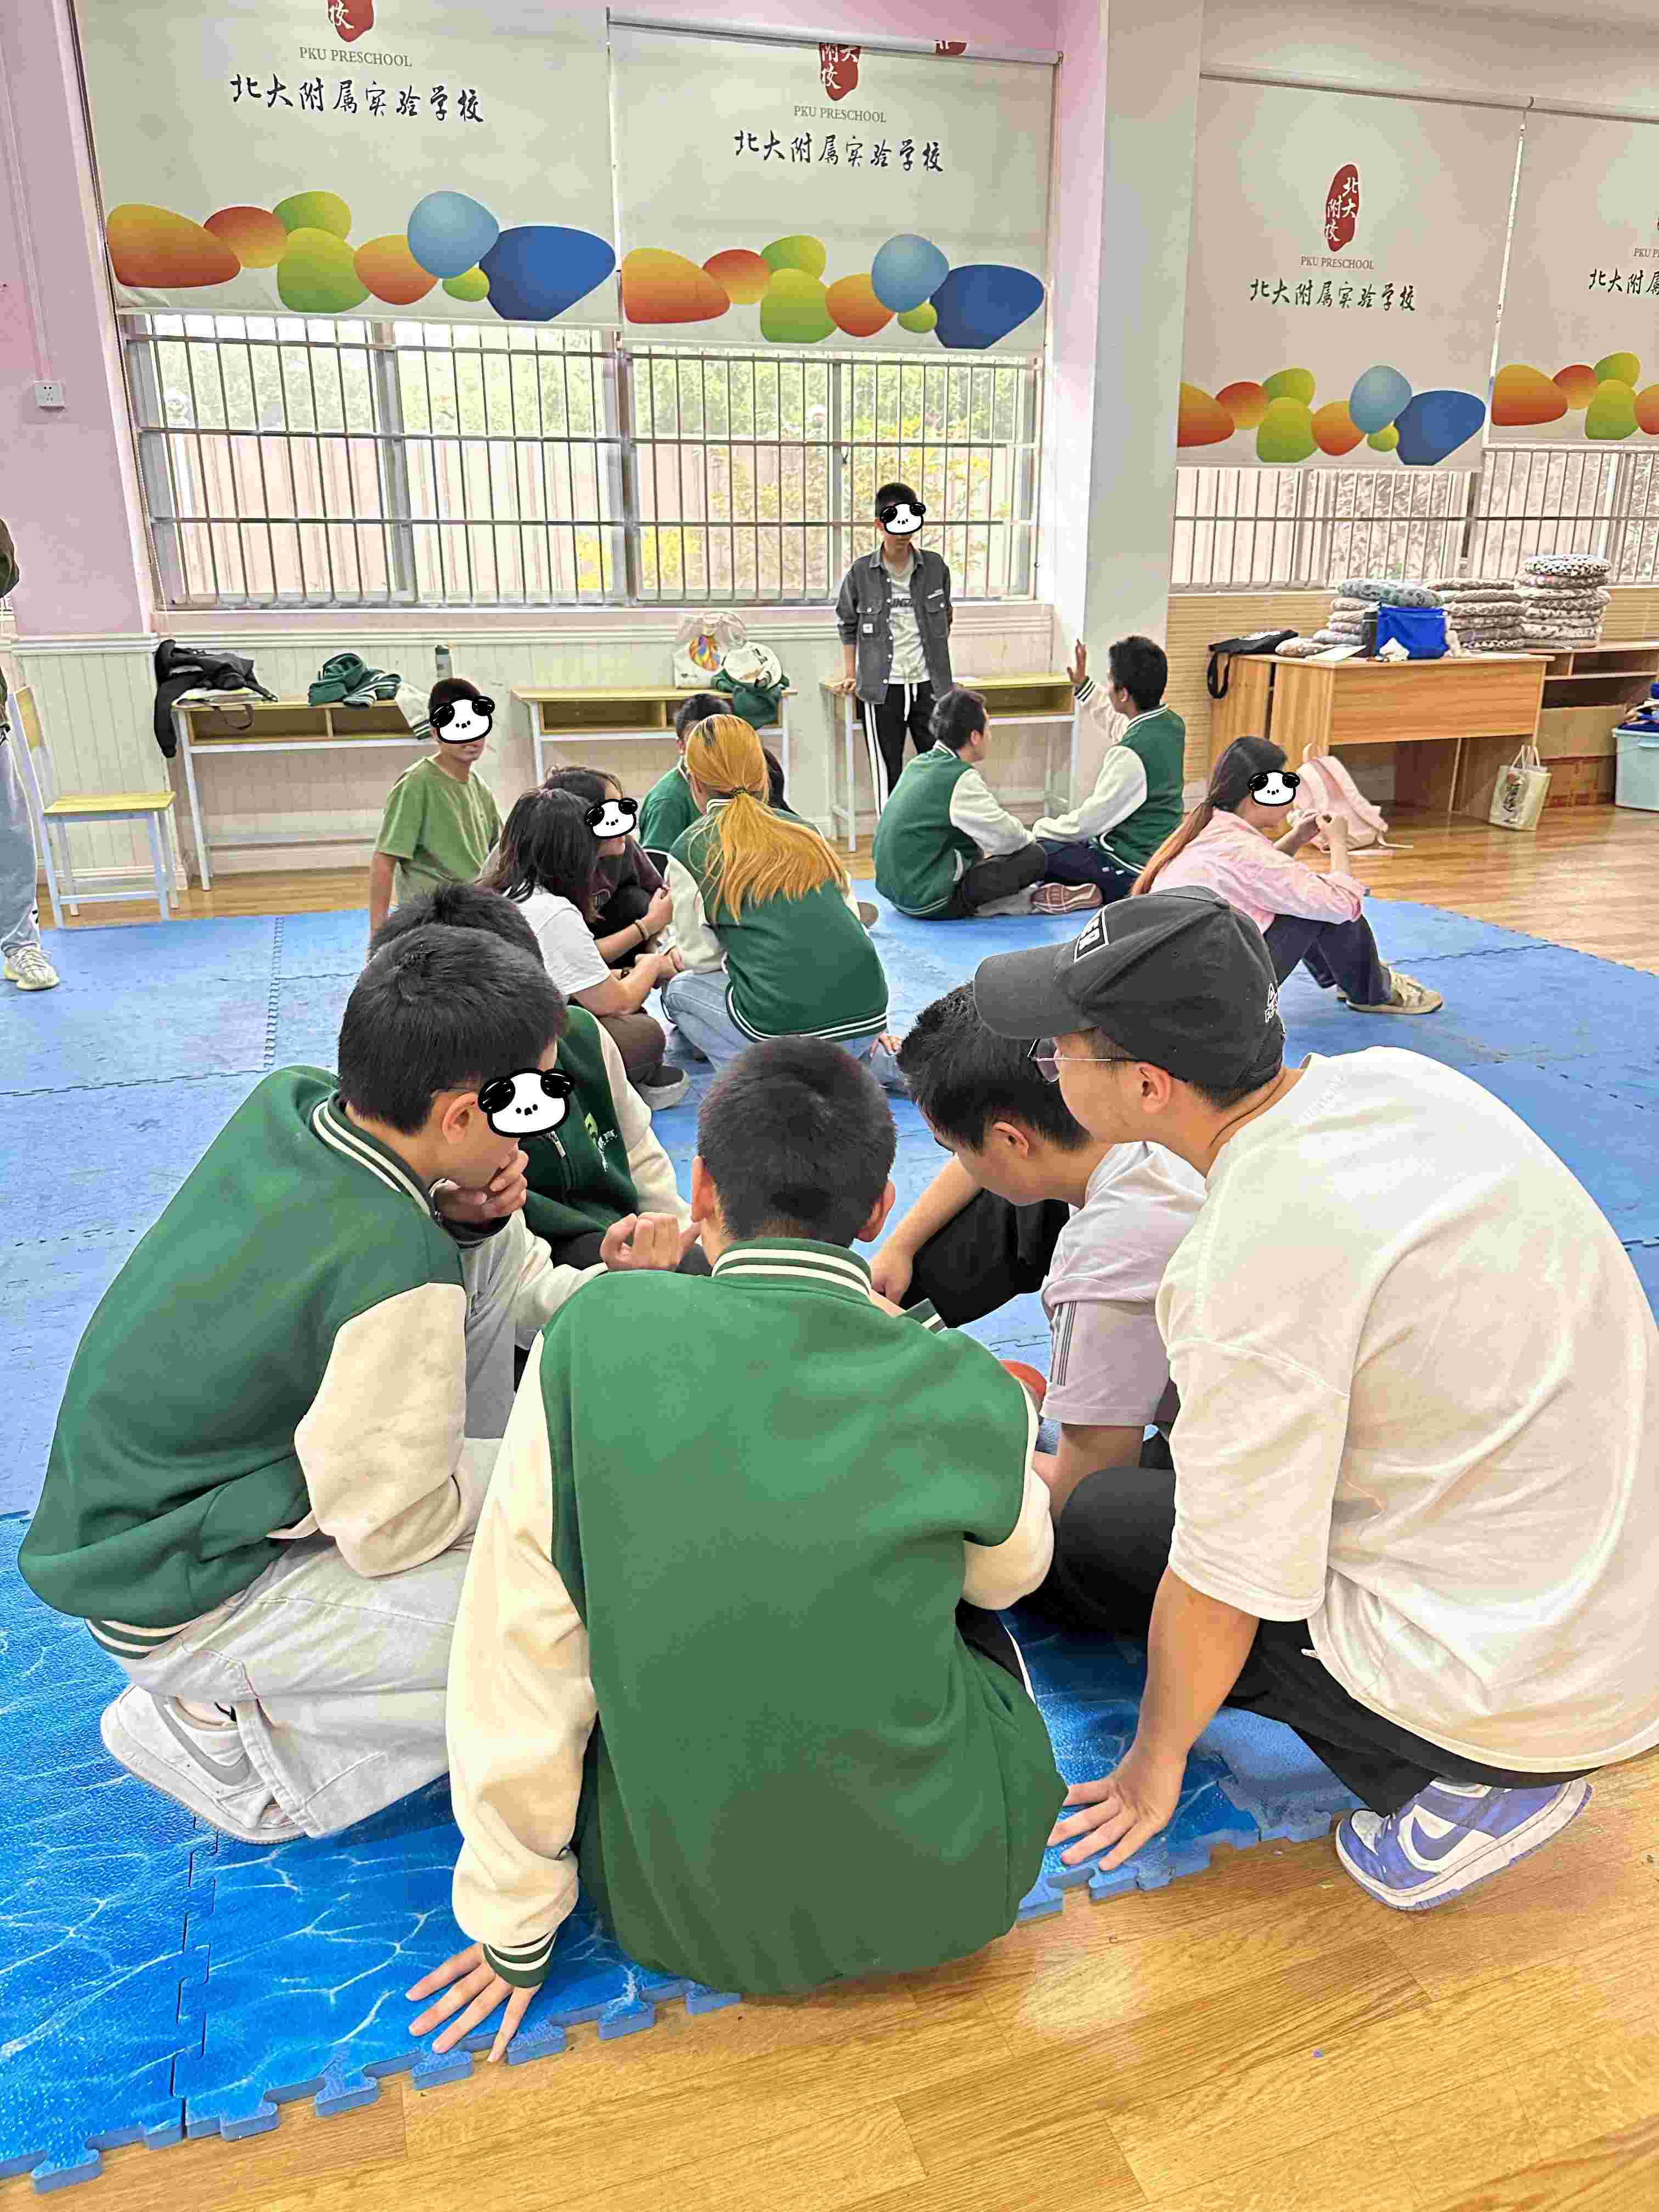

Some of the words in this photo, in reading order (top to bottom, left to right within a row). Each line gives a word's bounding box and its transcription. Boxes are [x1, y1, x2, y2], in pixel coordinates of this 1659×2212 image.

[299, 47, 326, 60] PKU
[330, 49, 413, 66] PRESCHOOL
[230, 74, 484, 123] 北大附属实验学校
[794, 105, 817, 117] PKU
[820, 108, 887, 123] PRESCHOOL
[734, 130, 944, 172] 北大附属实验学校
[1634, 248, 1651, 257] PKU
[1301, 256, 1318, 267] PKU
[1321, 258, 1374, 270] PRESCHOOL
[1250, 277, 1415, 311] 北大附属实验学校
